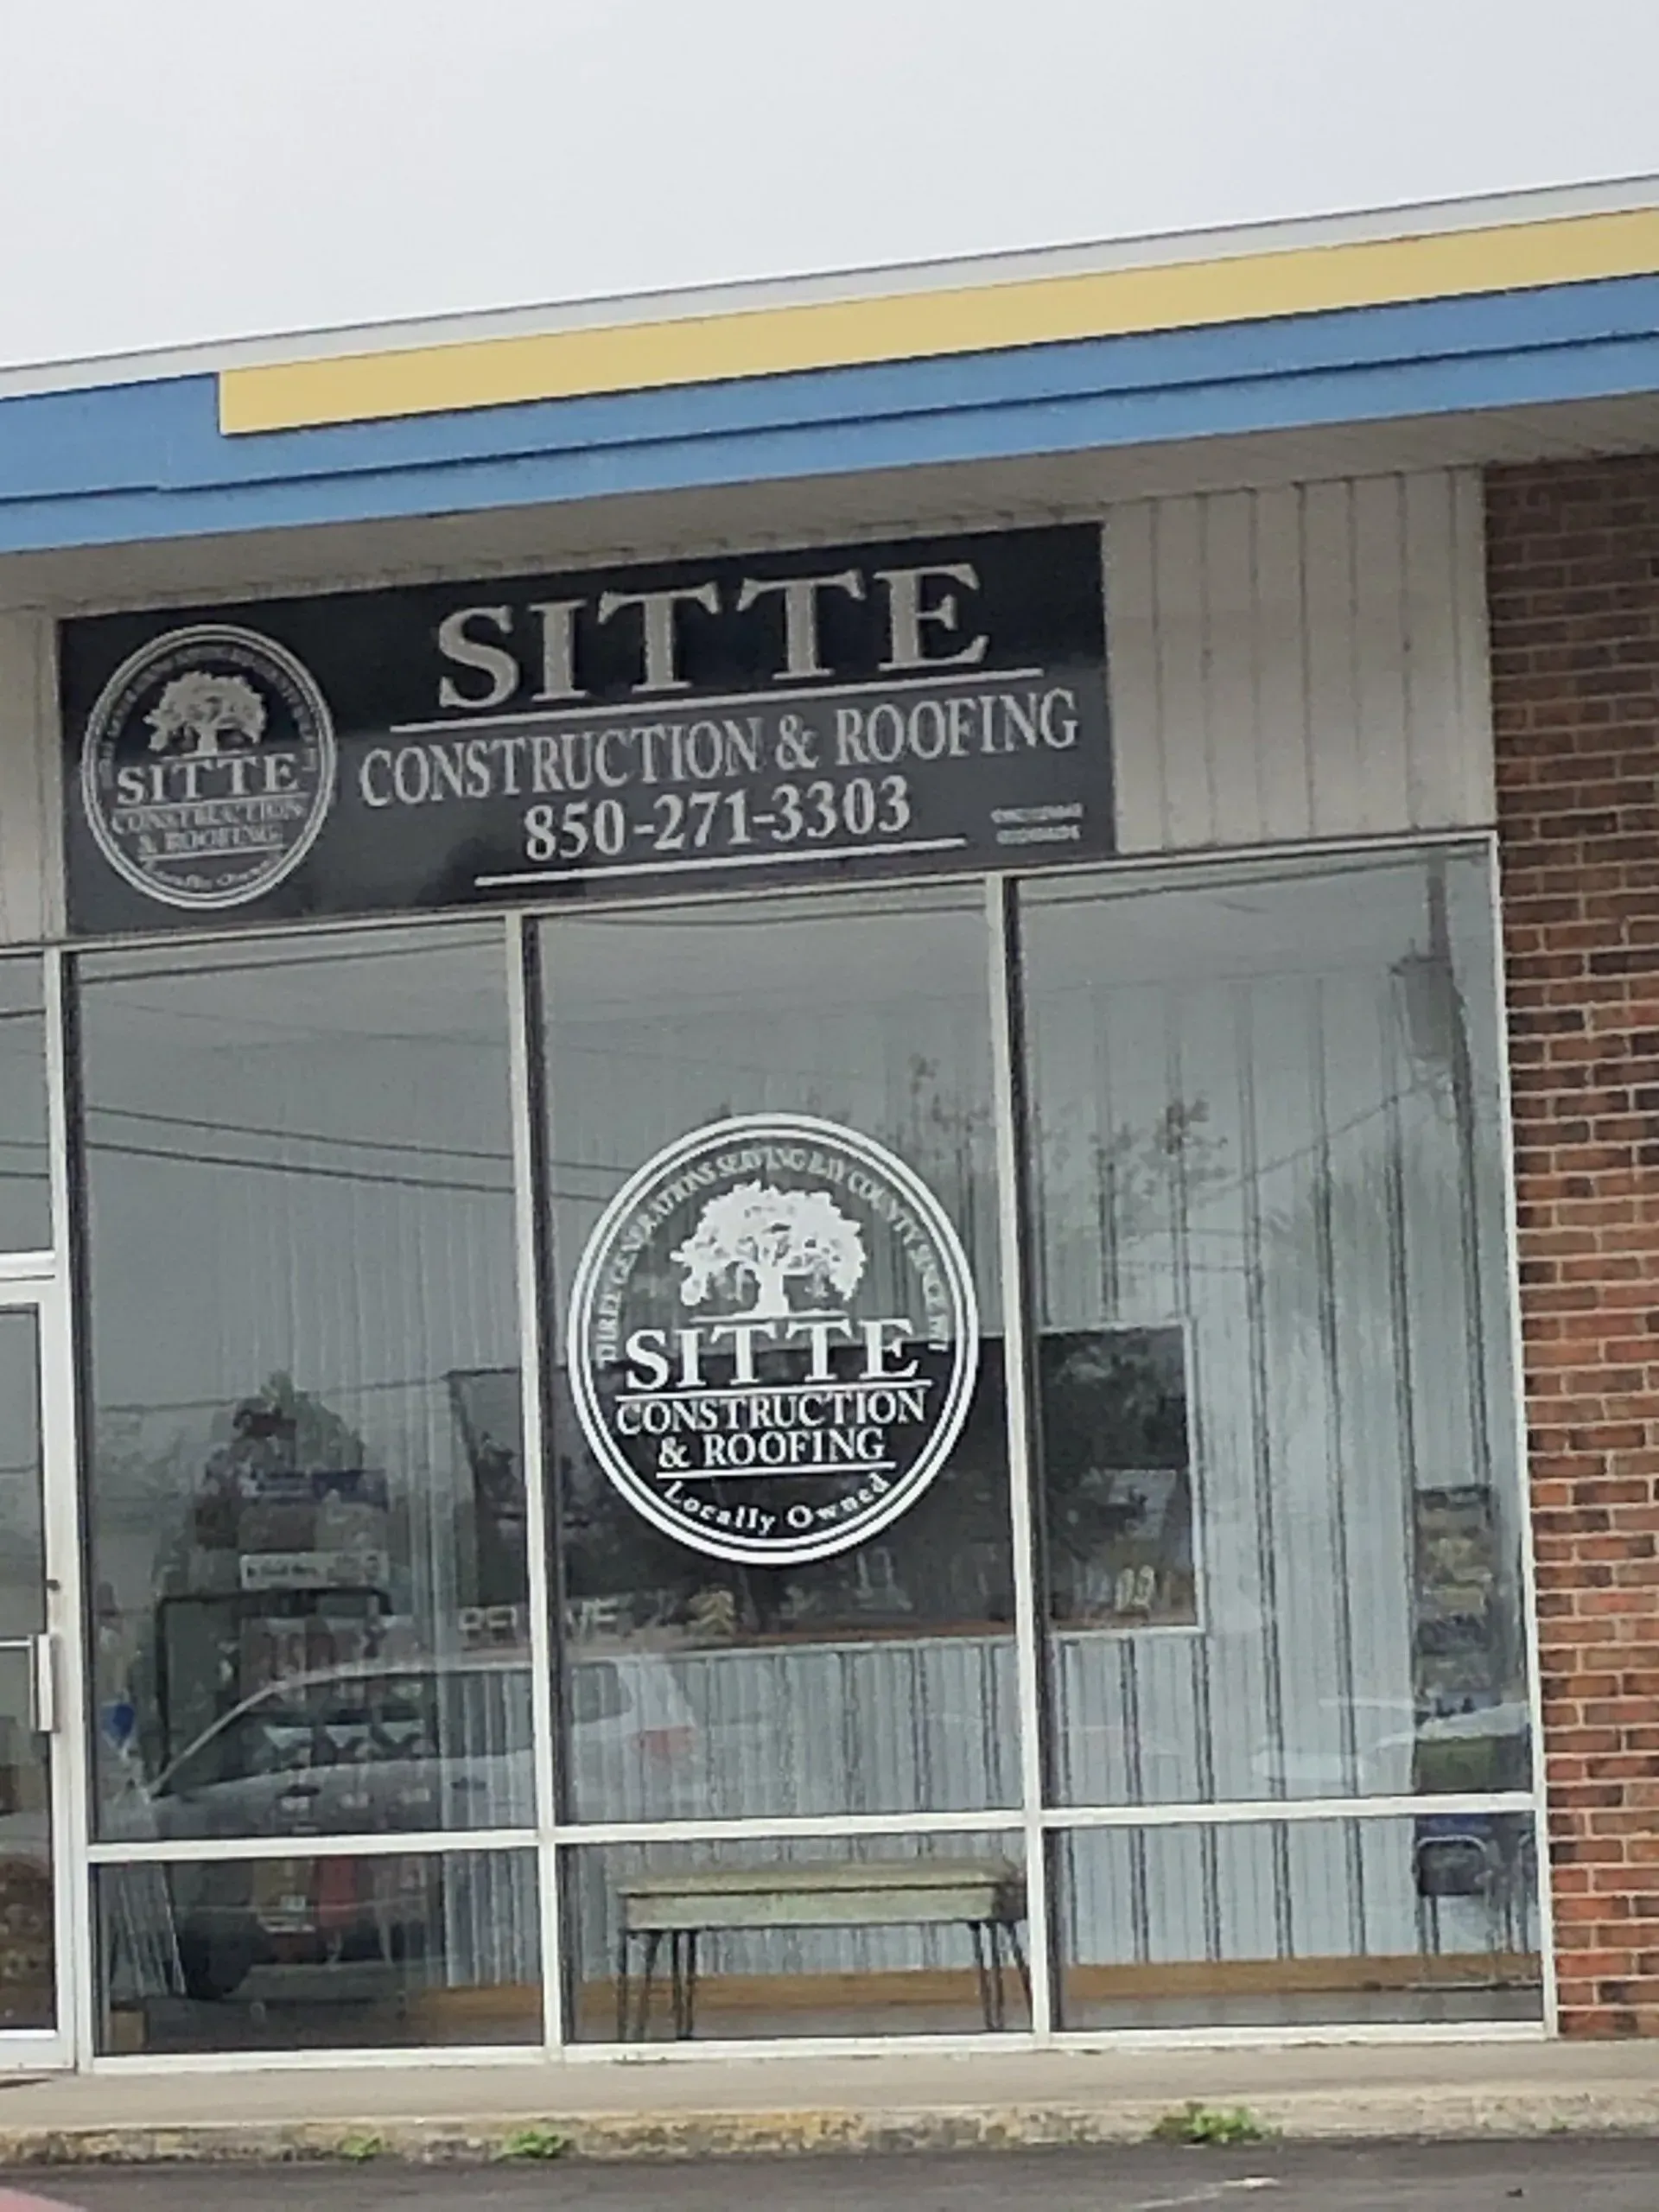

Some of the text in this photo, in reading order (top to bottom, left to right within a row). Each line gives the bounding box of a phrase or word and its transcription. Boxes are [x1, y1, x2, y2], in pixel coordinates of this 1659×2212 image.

[438, 563, 988, 709] SITTE
[117, 753, 300, 805] SITTE
[360, 688, 1078, 808] CONSTRUCTION & ROOFING
[524, 776, 911, 861] 850-271-3303
[625, 1319, 918, 1391] SITTE
[615, 1388, 927, 1436] CONSTRUCTION
[658, 1427, 886, 1469] & ROOFING
[663, 1471, 891, 1536] Locally Owned
